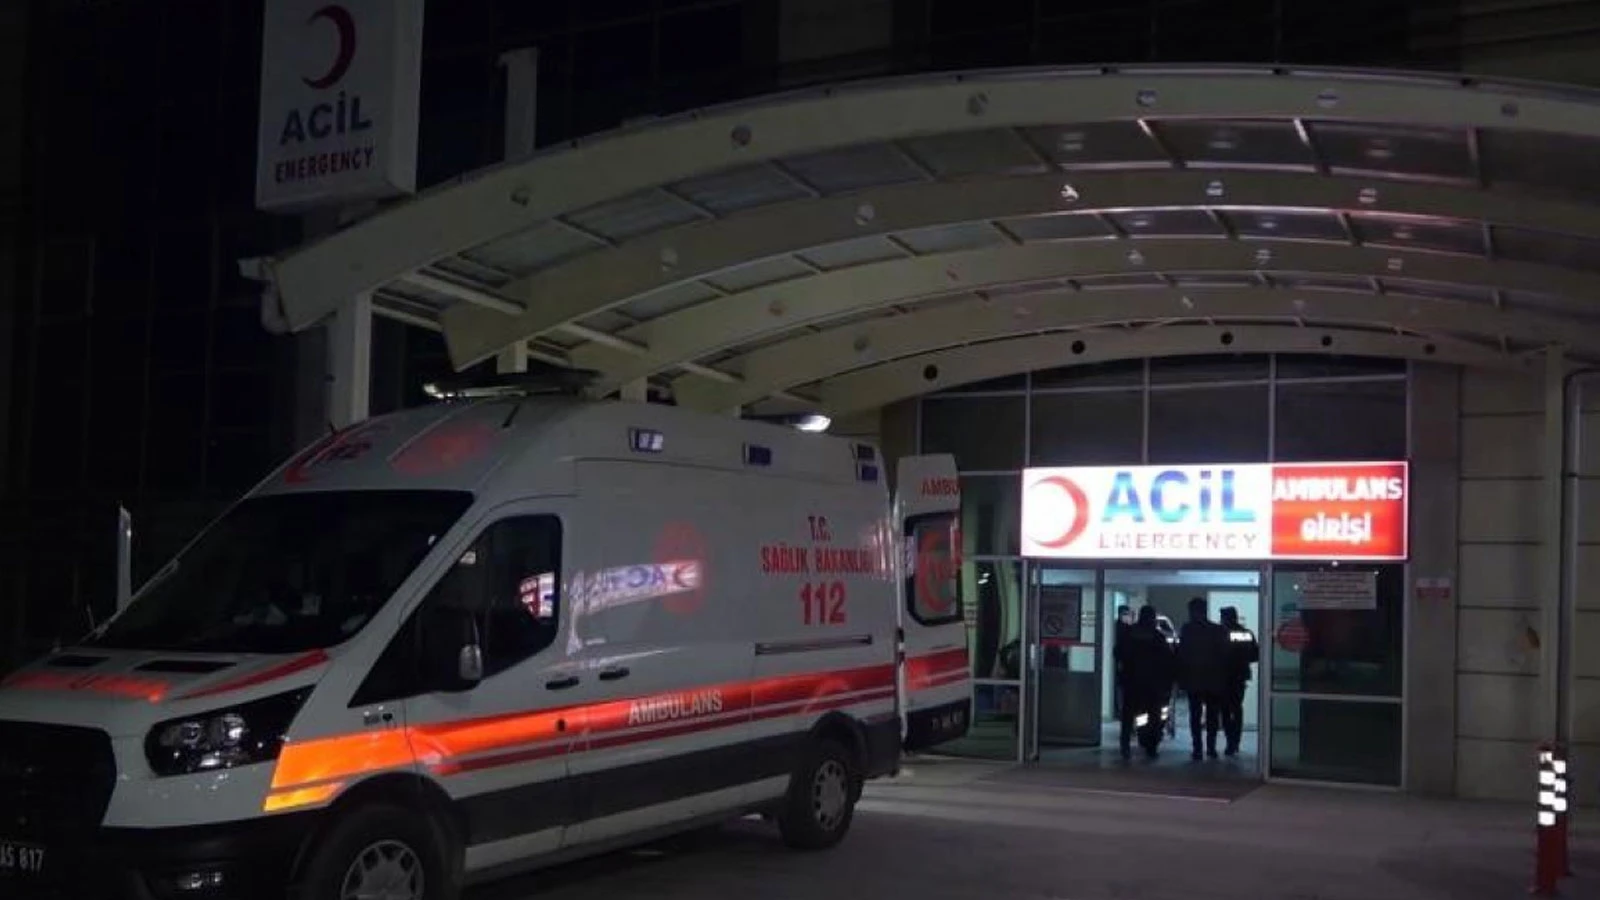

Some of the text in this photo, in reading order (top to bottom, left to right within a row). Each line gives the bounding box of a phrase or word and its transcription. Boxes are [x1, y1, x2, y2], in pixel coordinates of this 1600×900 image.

[280, 91, 372, 145] ACİL
[275, 147, 374, 183] EMERGENCY
[1101, 470, 1258, 522] ACİL
[1272, 477, 1403, 500] AMBULANS
[807, 515, 831, 541] T.C.
[1099, 532, 1258, 549] EMERGENCY
[1302, 511, 1371, 545] GİRİŞİ
[761, 542, 809, 574] SAĞLIK
[800, 581, 845, 626] 112
[628, 689, 723, 725] AMBULANS
